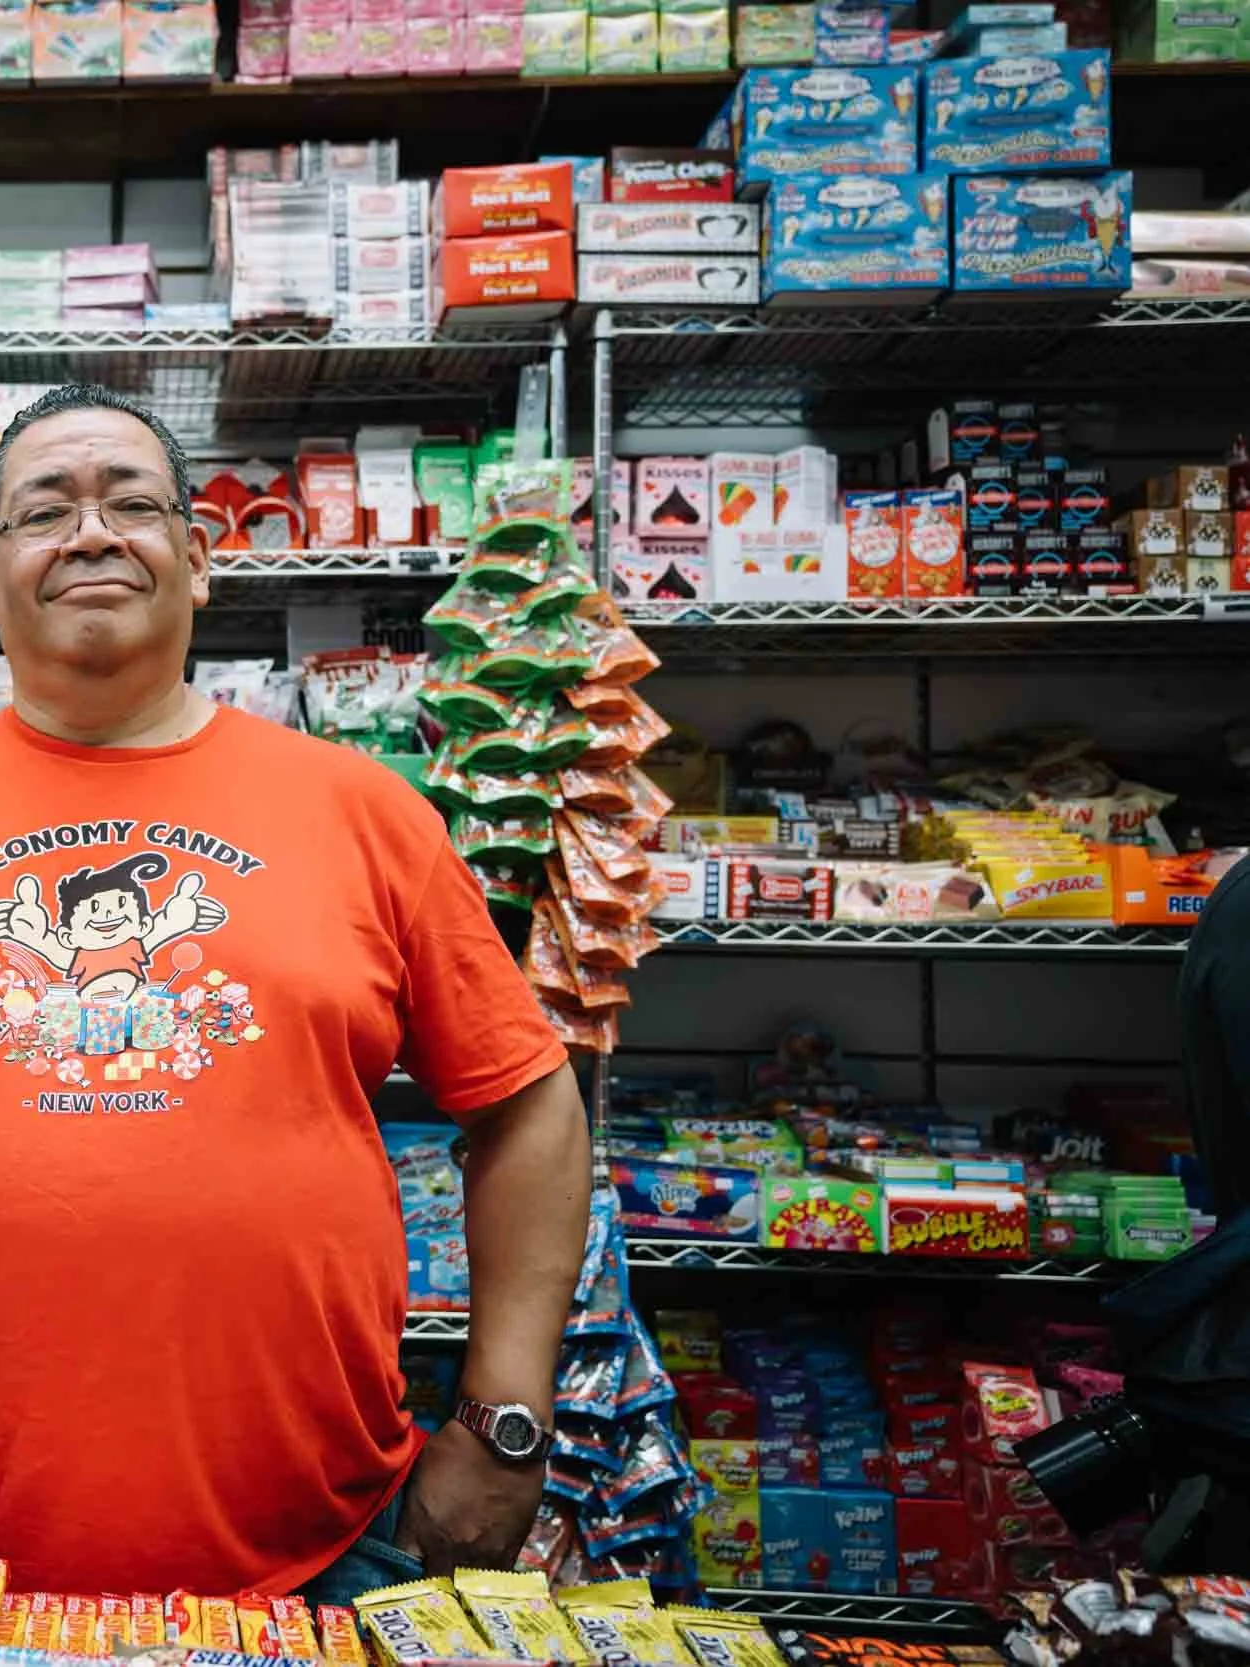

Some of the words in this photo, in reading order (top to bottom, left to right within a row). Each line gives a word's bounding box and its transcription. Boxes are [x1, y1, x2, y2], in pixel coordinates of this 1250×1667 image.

[145, 823, 265, 875] CANDY
[39, 1093, 95, 1112] NEW
[100, 1091, 169, 1112] YORK
[892, 1212, 989, 1250] BUBBLE
[968, 1227, 1025, 1252] GUM
[375, 1608, 411, 1641] POKE
[577, 1614, 616, 1649] POKE
